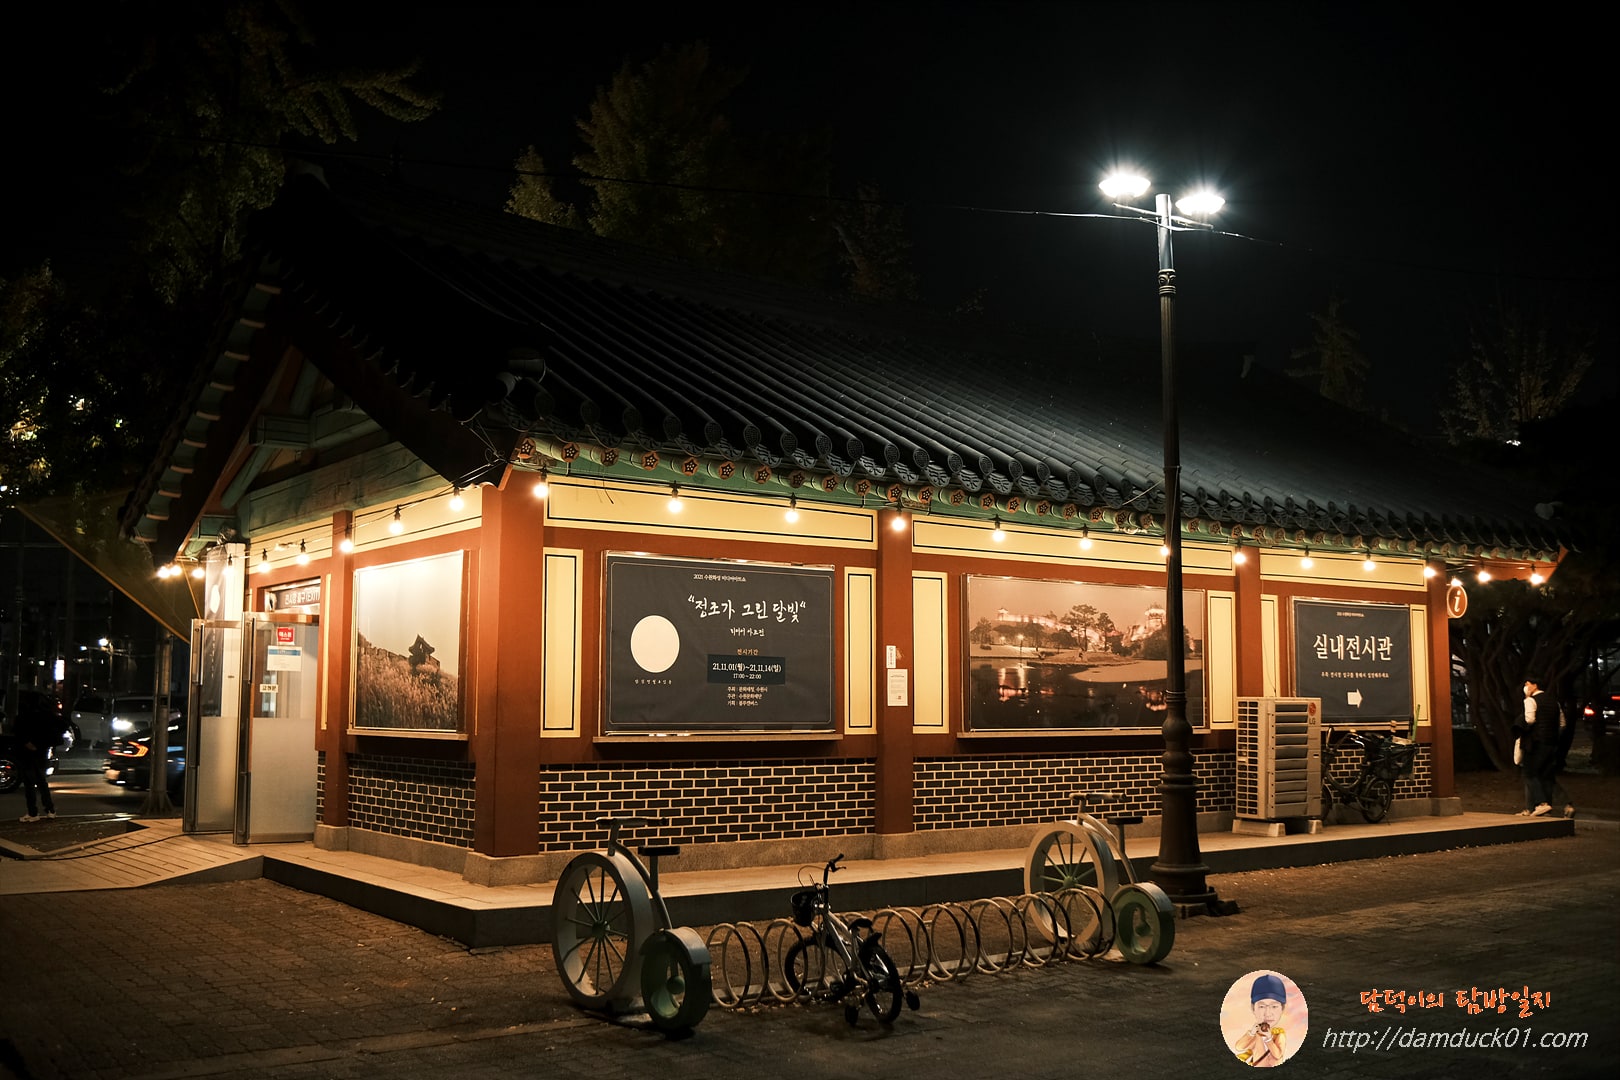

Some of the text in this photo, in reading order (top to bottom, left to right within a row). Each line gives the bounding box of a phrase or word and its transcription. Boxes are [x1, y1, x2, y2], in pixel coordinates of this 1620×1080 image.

[741, 600, 769, 619] 그린
[736, 648, 759, 656] 전시기간
[1313, 633, 1393, 662] 실내전시관
